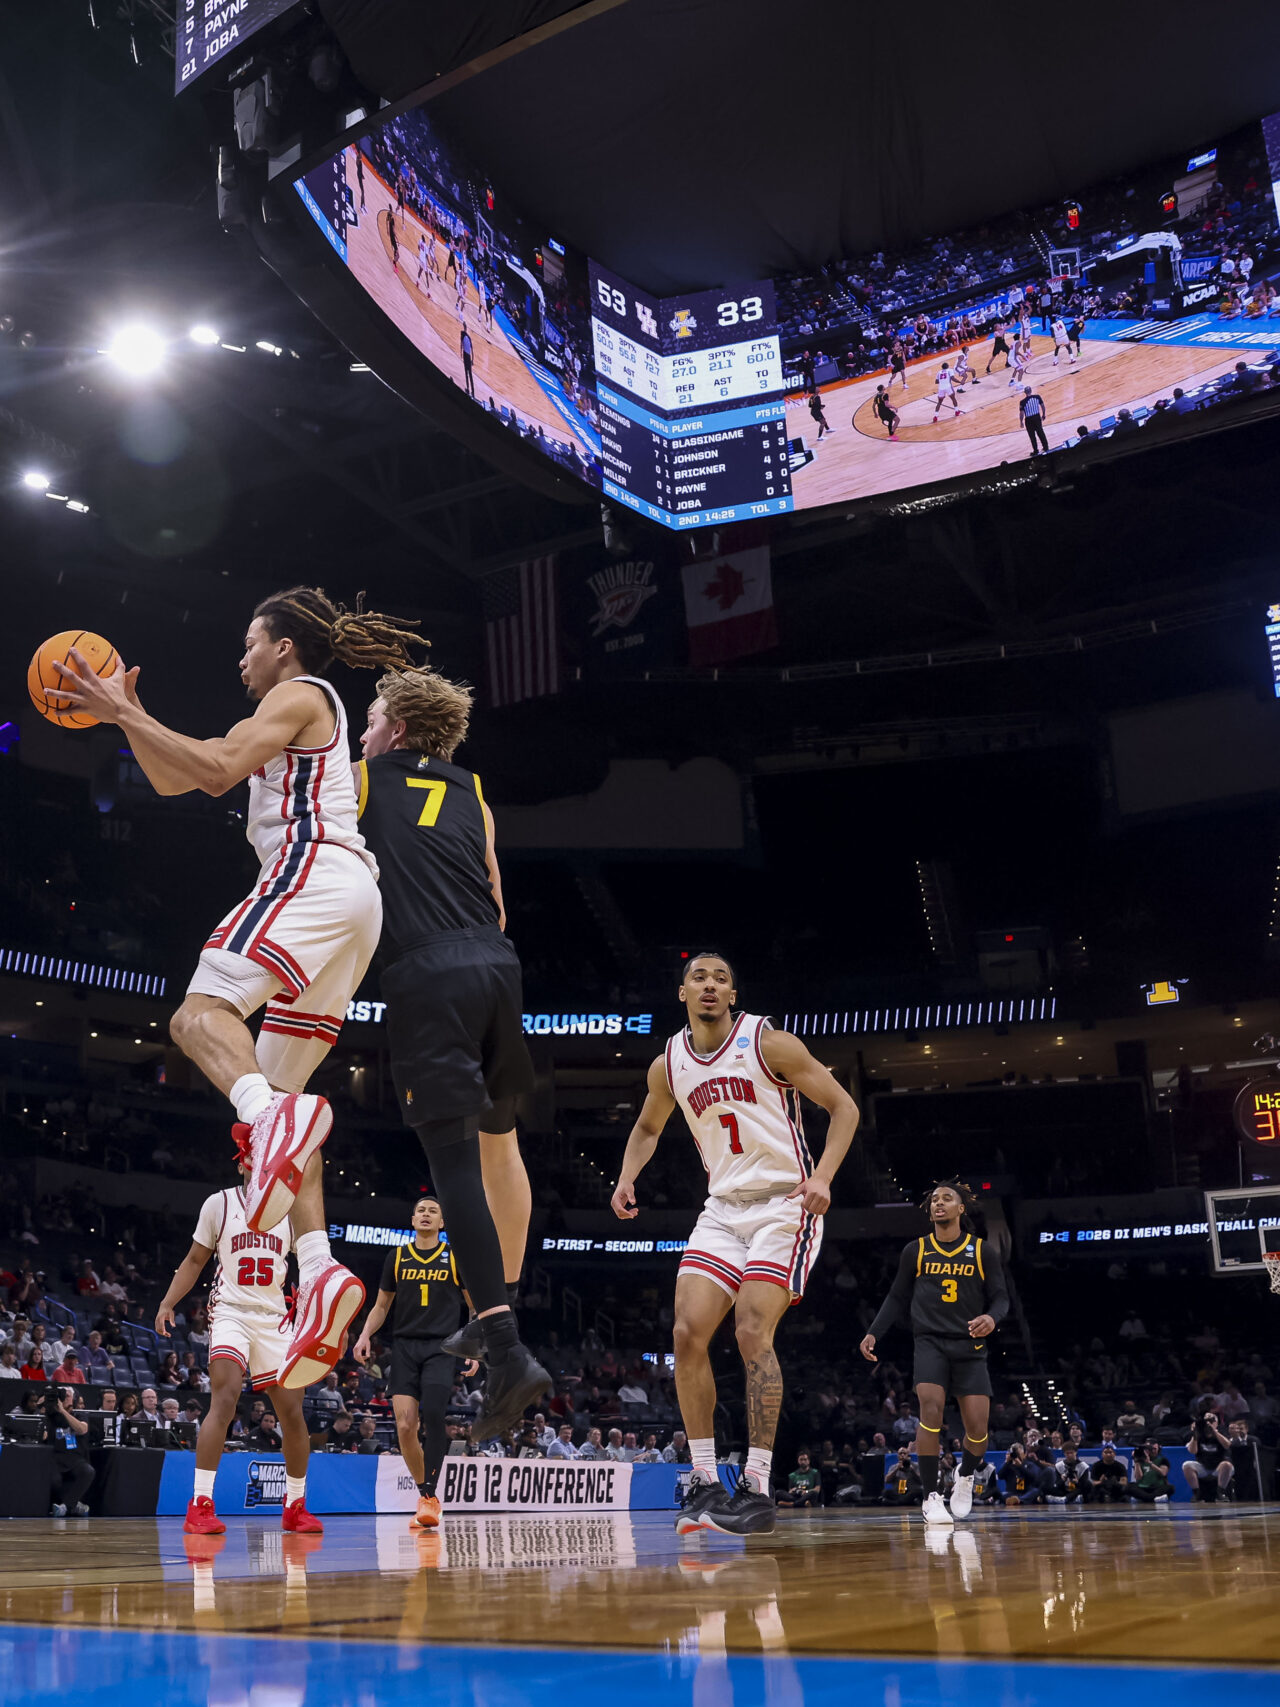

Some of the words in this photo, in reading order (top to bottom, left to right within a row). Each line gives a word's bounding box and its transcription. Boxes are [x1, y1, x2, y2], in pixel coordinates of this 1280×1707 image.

[185, 15, 195, 34] 5
[185, 36, 194, 55] 7
[204, 0, 249, 39] PAYNE
[181, 57, 197, 82] 21
[203, 23, 239, 63] JOBA
[597, 278, 627, 317] 53
[1183, 284, 1218, 308] NCAA
[717, 296, 763, 326] 33
[600, 351, 612, 365] REB
[623, 365, 635, 378] AST
[646, 352, 660, 366] FT%
[672, 357, 693, 367] FG%
[708, 349, 736, 361] 3PT%
[751, 341, 771, 353] FT%
[672, 366, 697, 379] 27.0
[709, 359, 732, 372] 21.1
[746, 350, 775, 365] 60.0
[675, 383, 695, 394] REB
[714, 376, 732, 387] AST
[755, 369, 769, 379] TO
[679, 392, 694, 404] 21
[720, 387, 729, 397] 6
[759, 379, 768, 390] 3
[599, 388, 618, 406] PLAYER
[599, 403, 630, 428] FLEMINGS
[662, 436, 668, 449] 2
[671, 421, 703, 433] PLAYER
[755, 409, 770, 419] PTS
[772, 406, 786, 415] FLS
[600, 418, 617, 436] UZAN
[654, 449, 660, 459] 7
[601, 433, 622, 453] SAKHO
[671, 430, 744, 449] BLASSINGAME
[761, 424, 769, 434] 4
[776, 422, 784, 430] 2
[602, 449, 632, 474] MCCARTY
[672, 450, 719, 465] JOHNSON
[762, 440, 770, 449] 5
[778, 437, 785, 446] 3
[674, 464, 726, 480] BRICKNER
[763, 455, 771, 465] 4
[779, 452, 787, 461] 0
[603, 465, 627, 487] MILLER
[657, 495, 663, 506] 2
[675, 482, 707, 495] PAYNE
[765, 471, 773, 480] 3
[780, 468, 788, 477] 0
[605, 481, 618, 497] 2ND
[620, 490, 640, 509] 14:25
[648, 506, 661, 519] TOL
[676, 499, 702, 511] JOBA
[766, 487, 774, 496] 0
[782, 484, 789, 492] 1
[678, 515, 700, 526] 2ND
[704, 509, 735, 521] 14:25
[750, 504, 770, 514] TOL
[778, 501, 787, 509] 3
[586, 561, 654, 598] THUNDER
[405, 776, 447, 827] 7
[345, 1000, 387, 1023] RST
[522, 1012, 623, 1035] ROUNDS
[687, 1076, 758, 1118] HOUSTON
[718, 1112, 744, 1155] 7
[1253, 1110, 1280, 1141] 3
[231, 1231, 283, 1255] HOUSTON
[1077, 1229, 1111, 1241] 2026
[1114, 1228, 1130, 1240] DI
[1133, 1225, 1171, 1239] MEN'S
[1174, 1219, 1256, 1236] BASKTBALL
[557, 1238, 593, 1251] FIRST
[605, 1240, 654, 1252] SECOND
[237, 1257, 274, 1287] 25
[401, 1268, 449, 1281] IDAHO
[925, 1262, 975, 1276] IDAHO
[420, 1283, 429, 1307] 1
[941, 1279, 958, 1303] 3
[444, 1463, 478, 1503] BIG
[484, 1463, 503, 1503] 12
[507, 1465, 615, 1504] CONFERENCE
